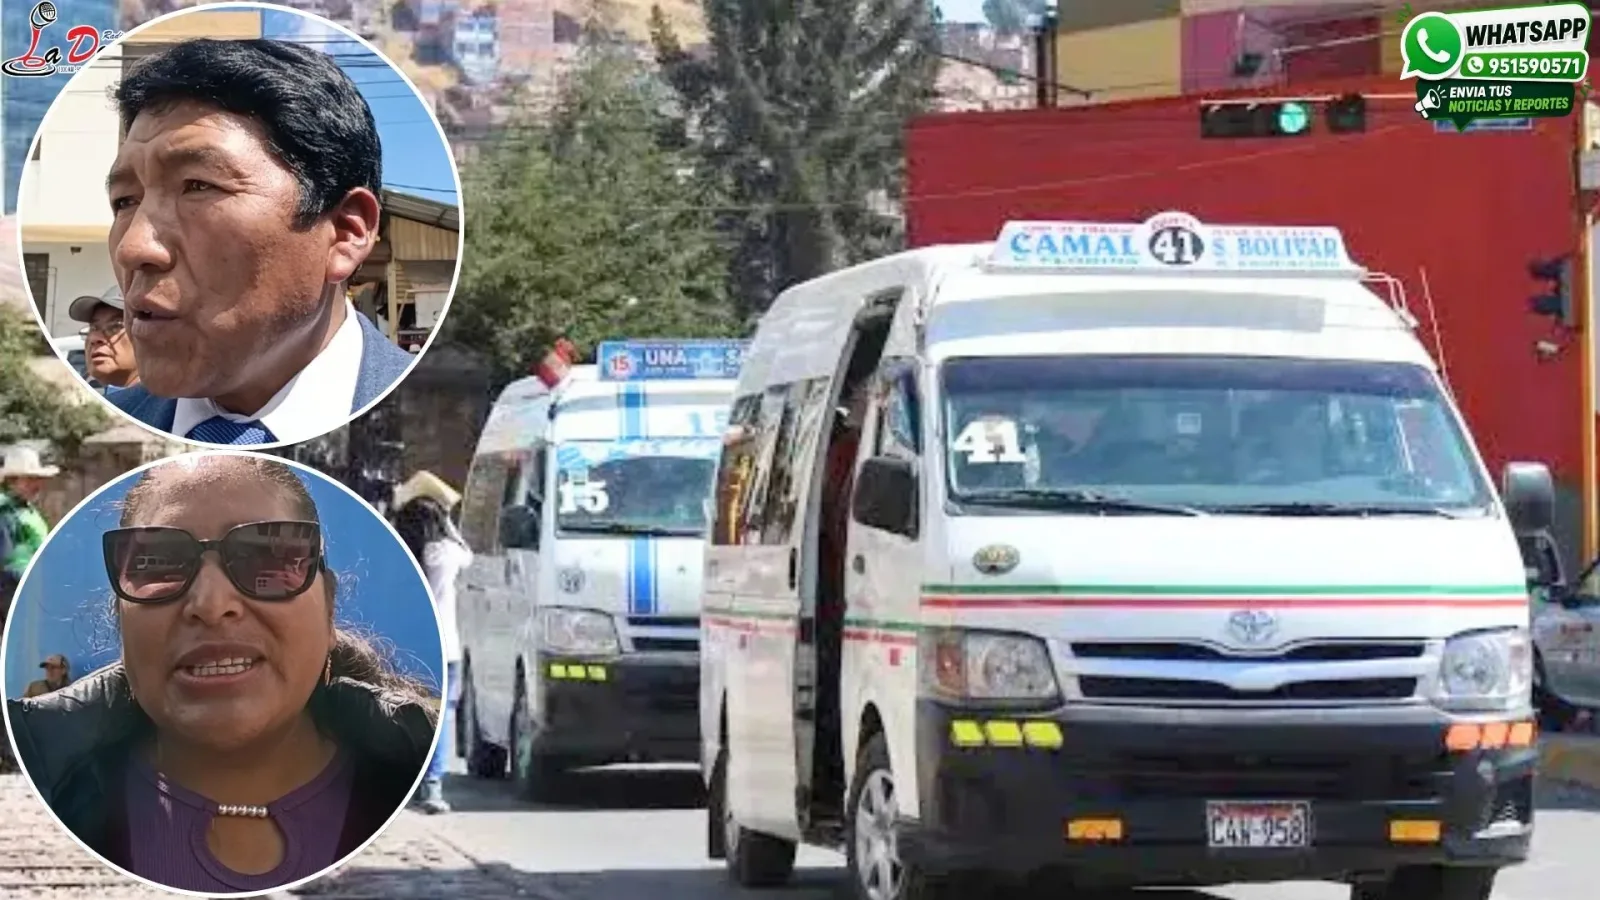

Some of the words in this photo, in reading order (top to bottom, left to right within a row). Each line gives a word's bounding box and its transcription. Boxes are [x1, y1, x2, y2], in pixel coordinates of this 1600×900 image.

[1009, 231, 1140, 256] CAMAL
[1153, 227, 1198, 265] 41
[1237, 236, 1339, 259] BOLIVAR
[610, 355, 631, 371] 15
[644, 350, 687, 366] UNA
[952, 419, 1028, 464] 41
[558, 480, 610, 515] 15
